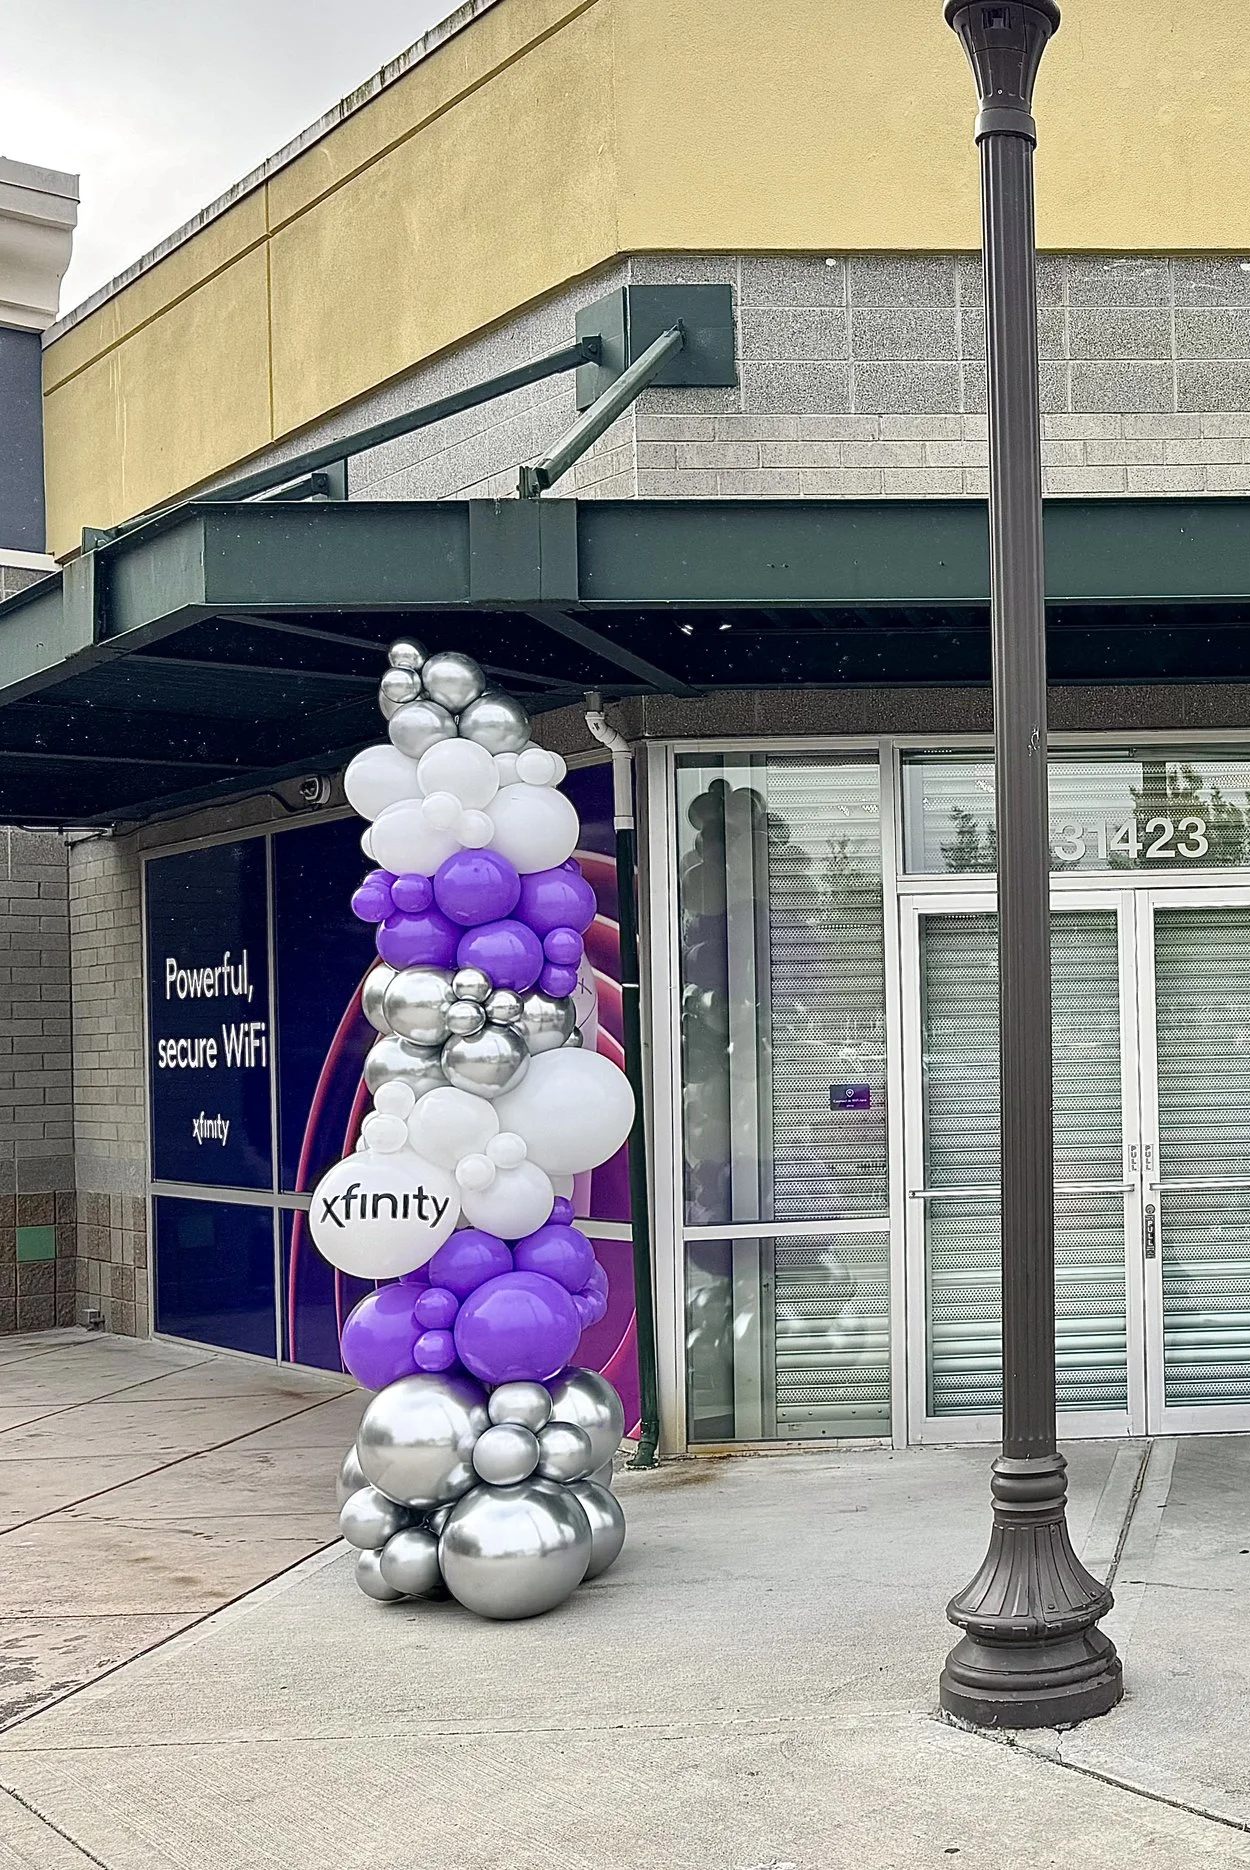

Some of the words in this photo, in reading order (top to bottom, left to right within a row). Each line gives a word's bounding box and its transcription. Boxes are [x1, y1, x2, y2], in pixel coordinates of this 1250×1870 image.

[1054, 816, 1209, 861] 31423
[166, 949, 254, 1003] Powerful,
[158, 1037, 217, 1069] secure
[222, 1022, 266, 1068] WiFi
[193, 1110, 230, 1147] xfinity
[319, 1182, 450, 1229] xfinity
